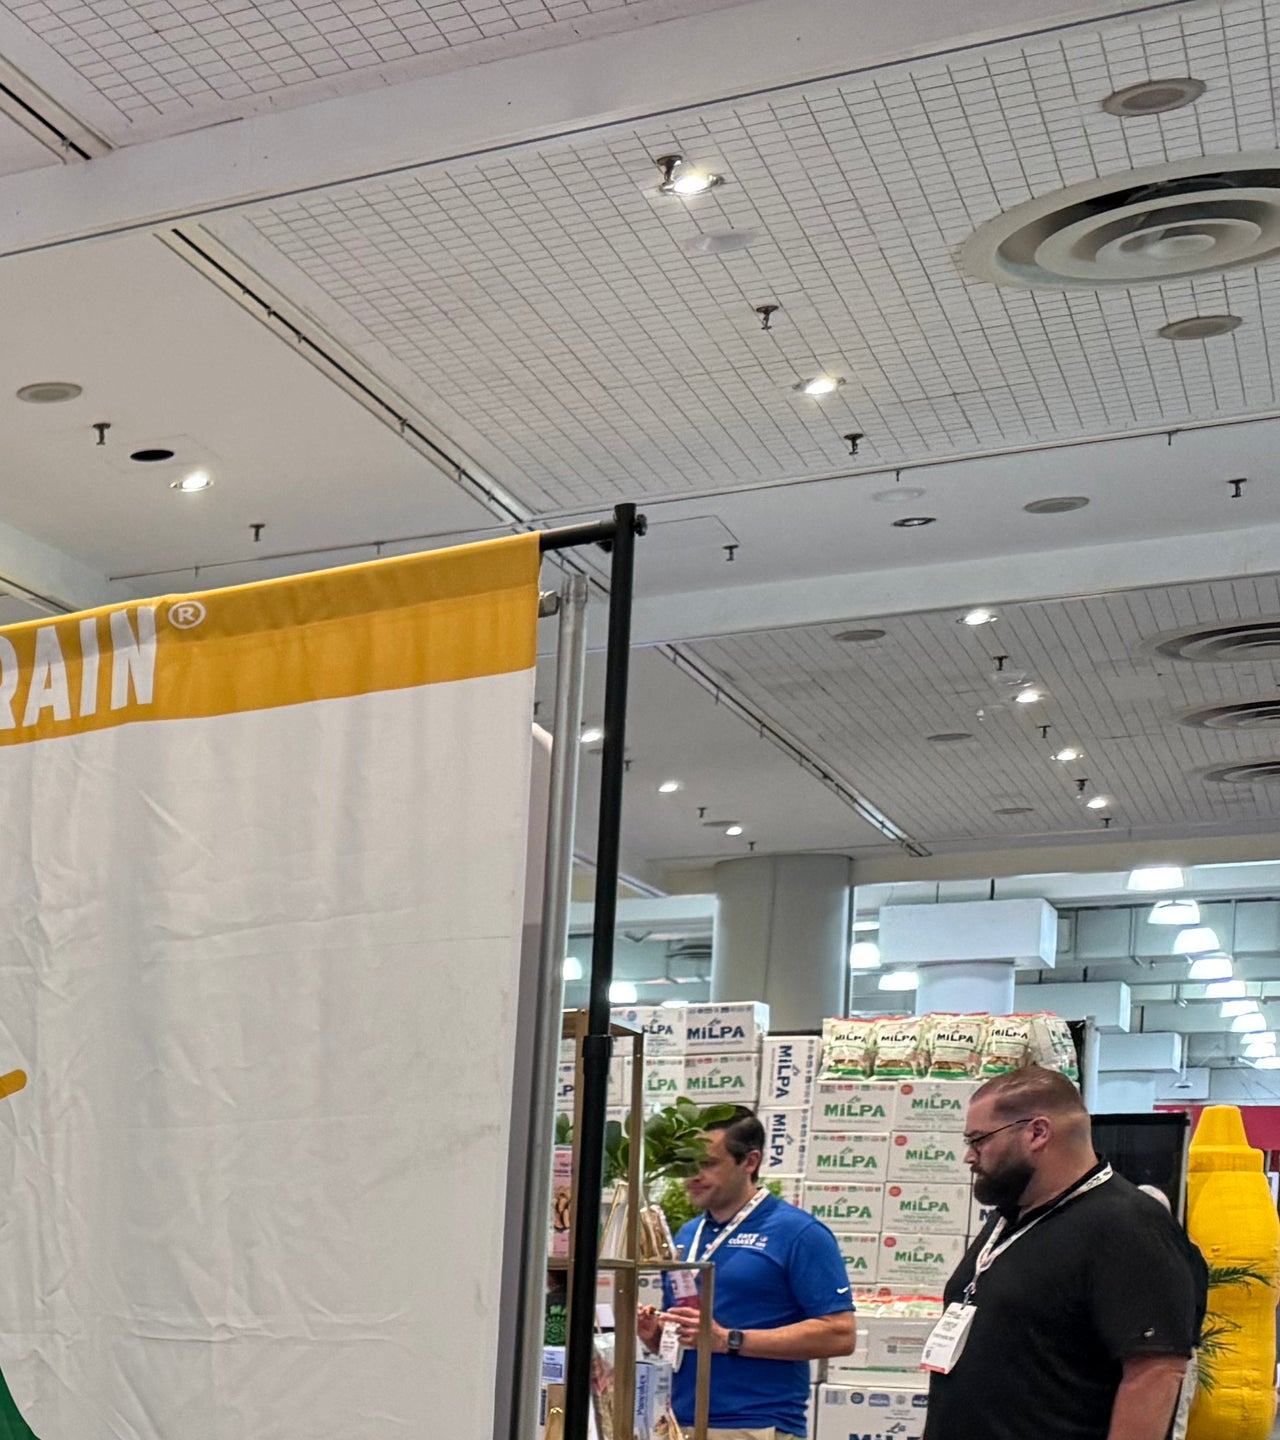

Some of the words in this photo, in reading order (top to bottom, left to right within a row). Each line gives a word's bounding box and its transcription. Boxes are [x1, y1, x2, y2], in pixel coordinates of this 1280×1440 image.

[911, 1098, 961, 1109] MiLPA
[824, 1103, 885, 1117] MiLPA
[906, 1149, 956, 1161] MiLPA
[817, 1155, 877, 1168] MiLPA
[811, 1205, 872, 1218] MiLPA
[900, 1200, 949, 1212] MiLPA
[894, 1251, 945, 1263] MiLPA
